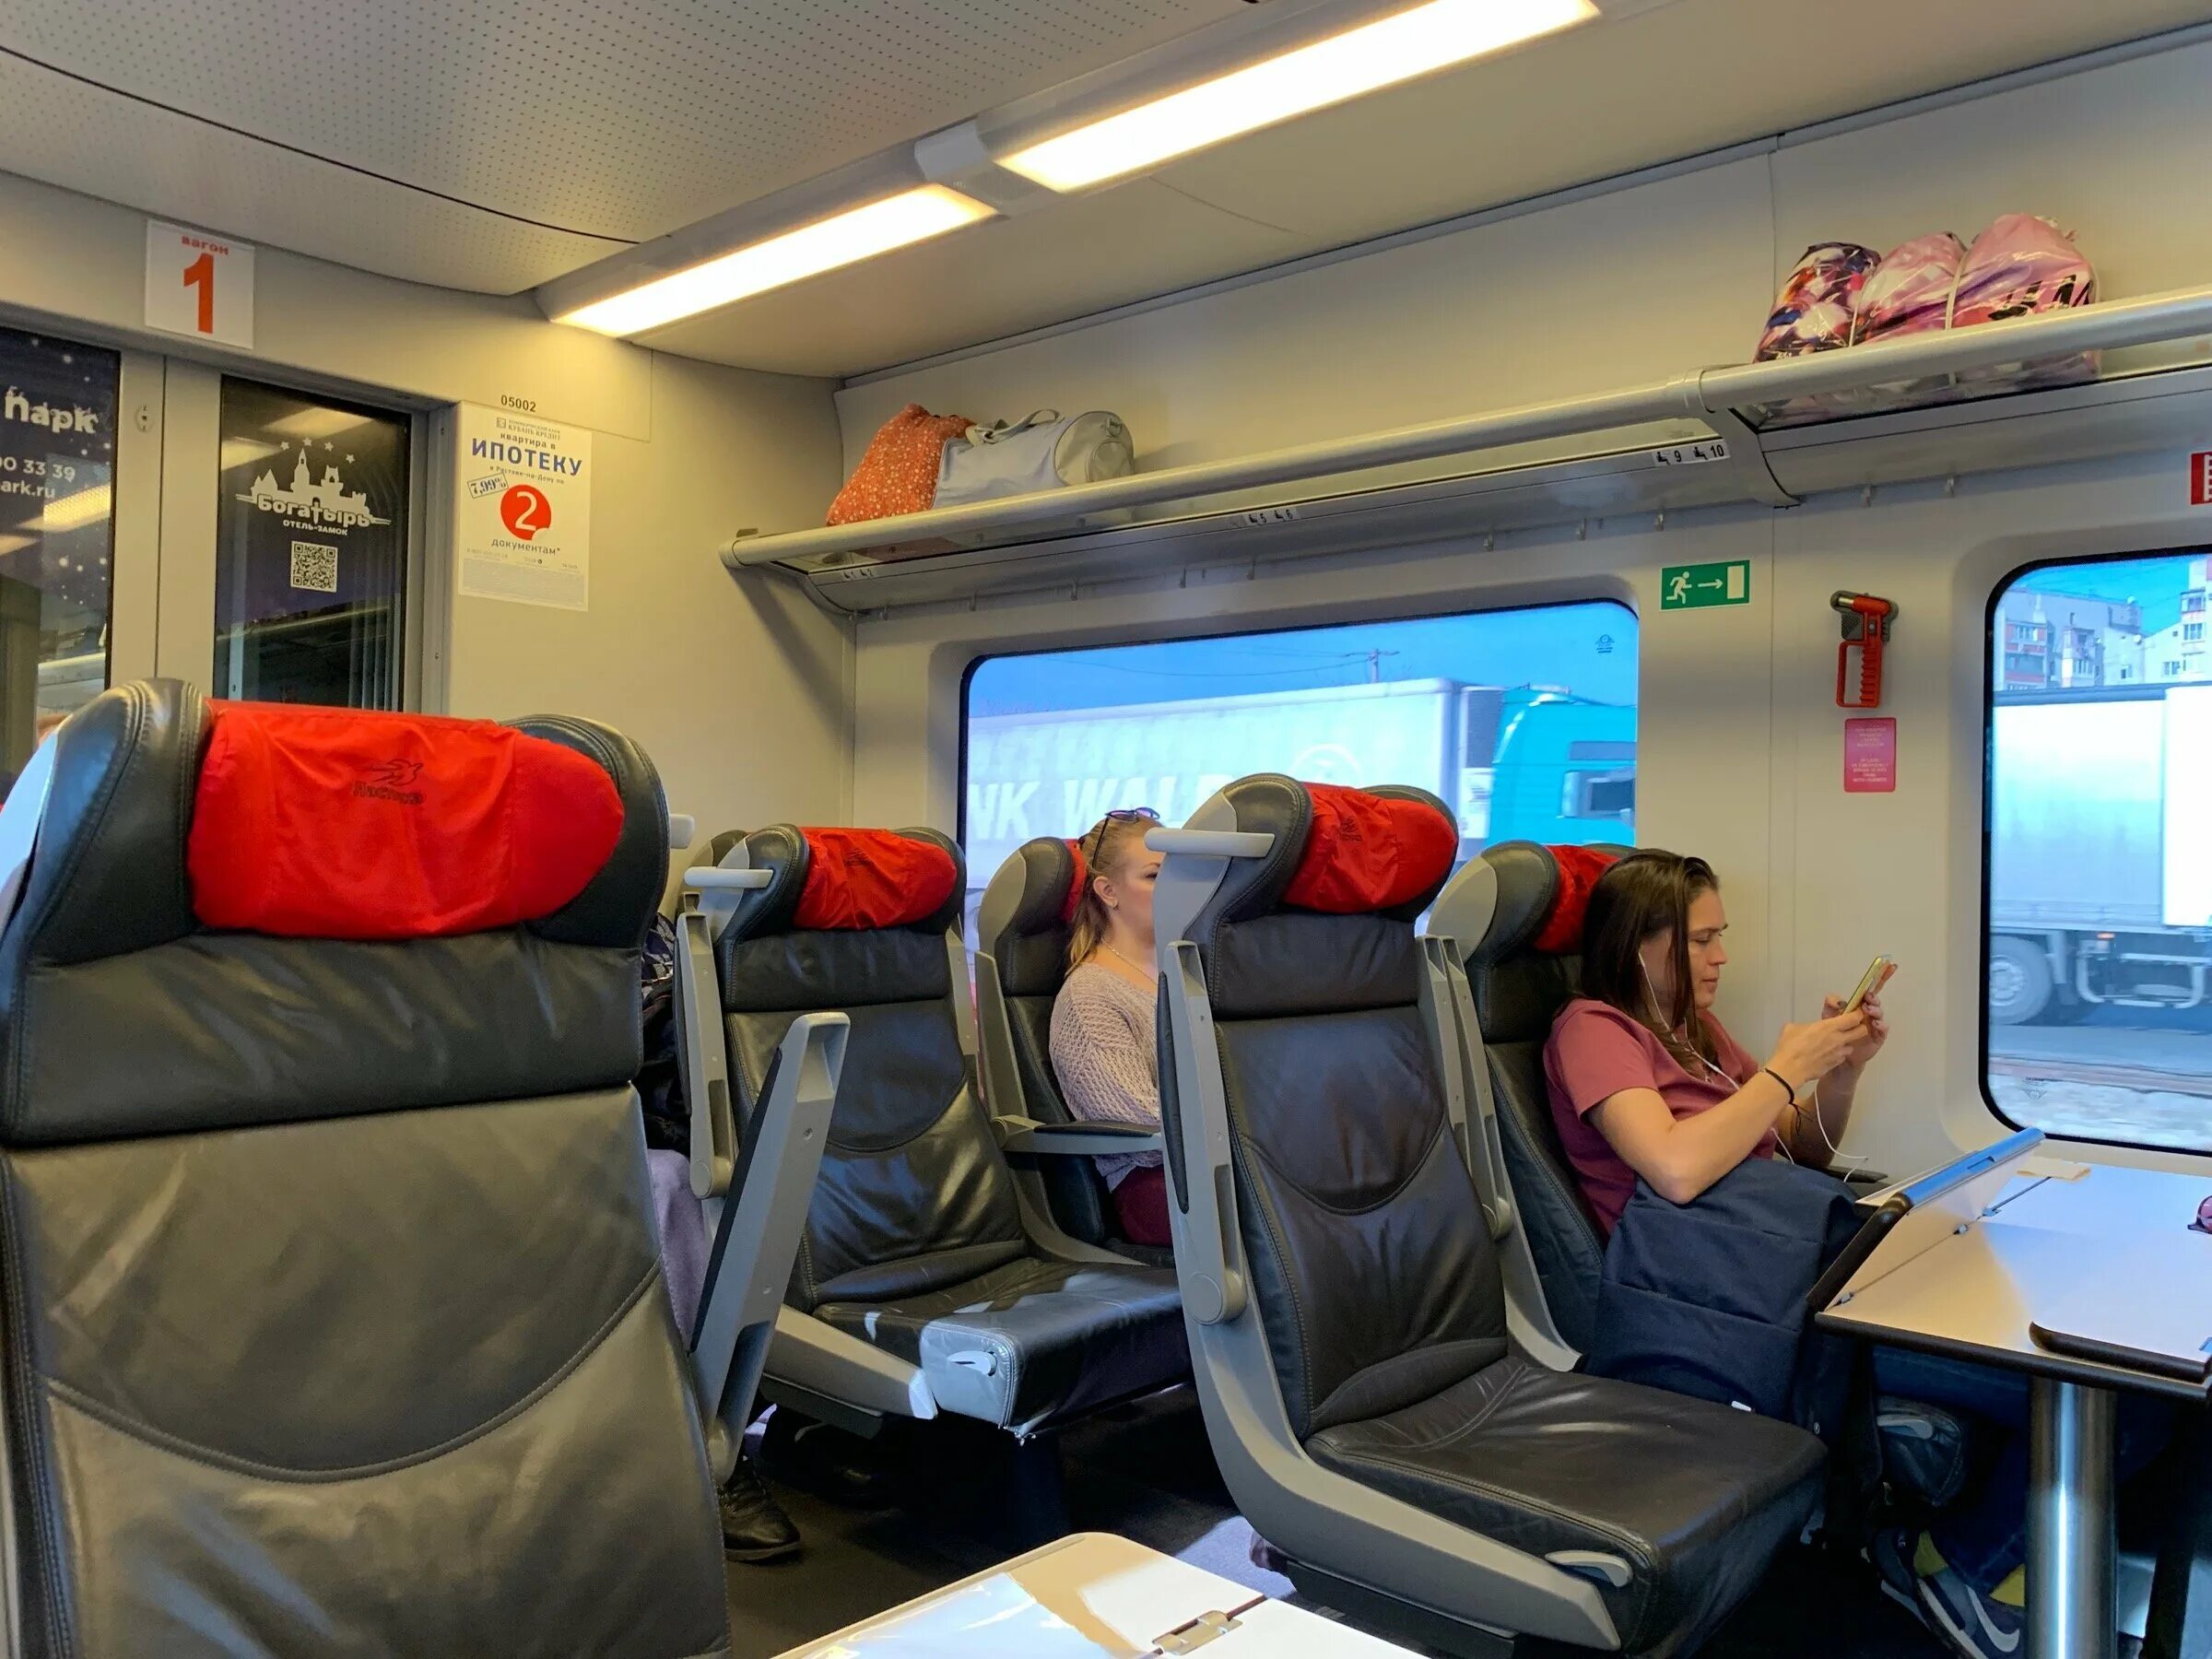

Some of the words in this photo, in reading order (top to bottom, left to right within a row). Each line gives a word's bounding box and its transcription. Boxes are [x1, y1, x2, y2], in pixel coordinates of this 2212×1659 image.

[182, 253, 214, 335] 1
[500, 394, 536, 413] 05002
[500, 432, 547, 449] квартира
[472, 438, 582, 477] ИПОТЕКУ
[1674, 450, 1682, 463] 9
[1710, 444, 1724, 457] 10
[23, 459, 46, 476] 33
[52, 464, 76, 483] 39
[470, 477, 506, 495] 7,99%
[257, 493, 371, 528] Богатырь
[515, 490, 537, 532] 2
[282, 520, 348, 536] ОТЕЛЬ-ЗАМОК
